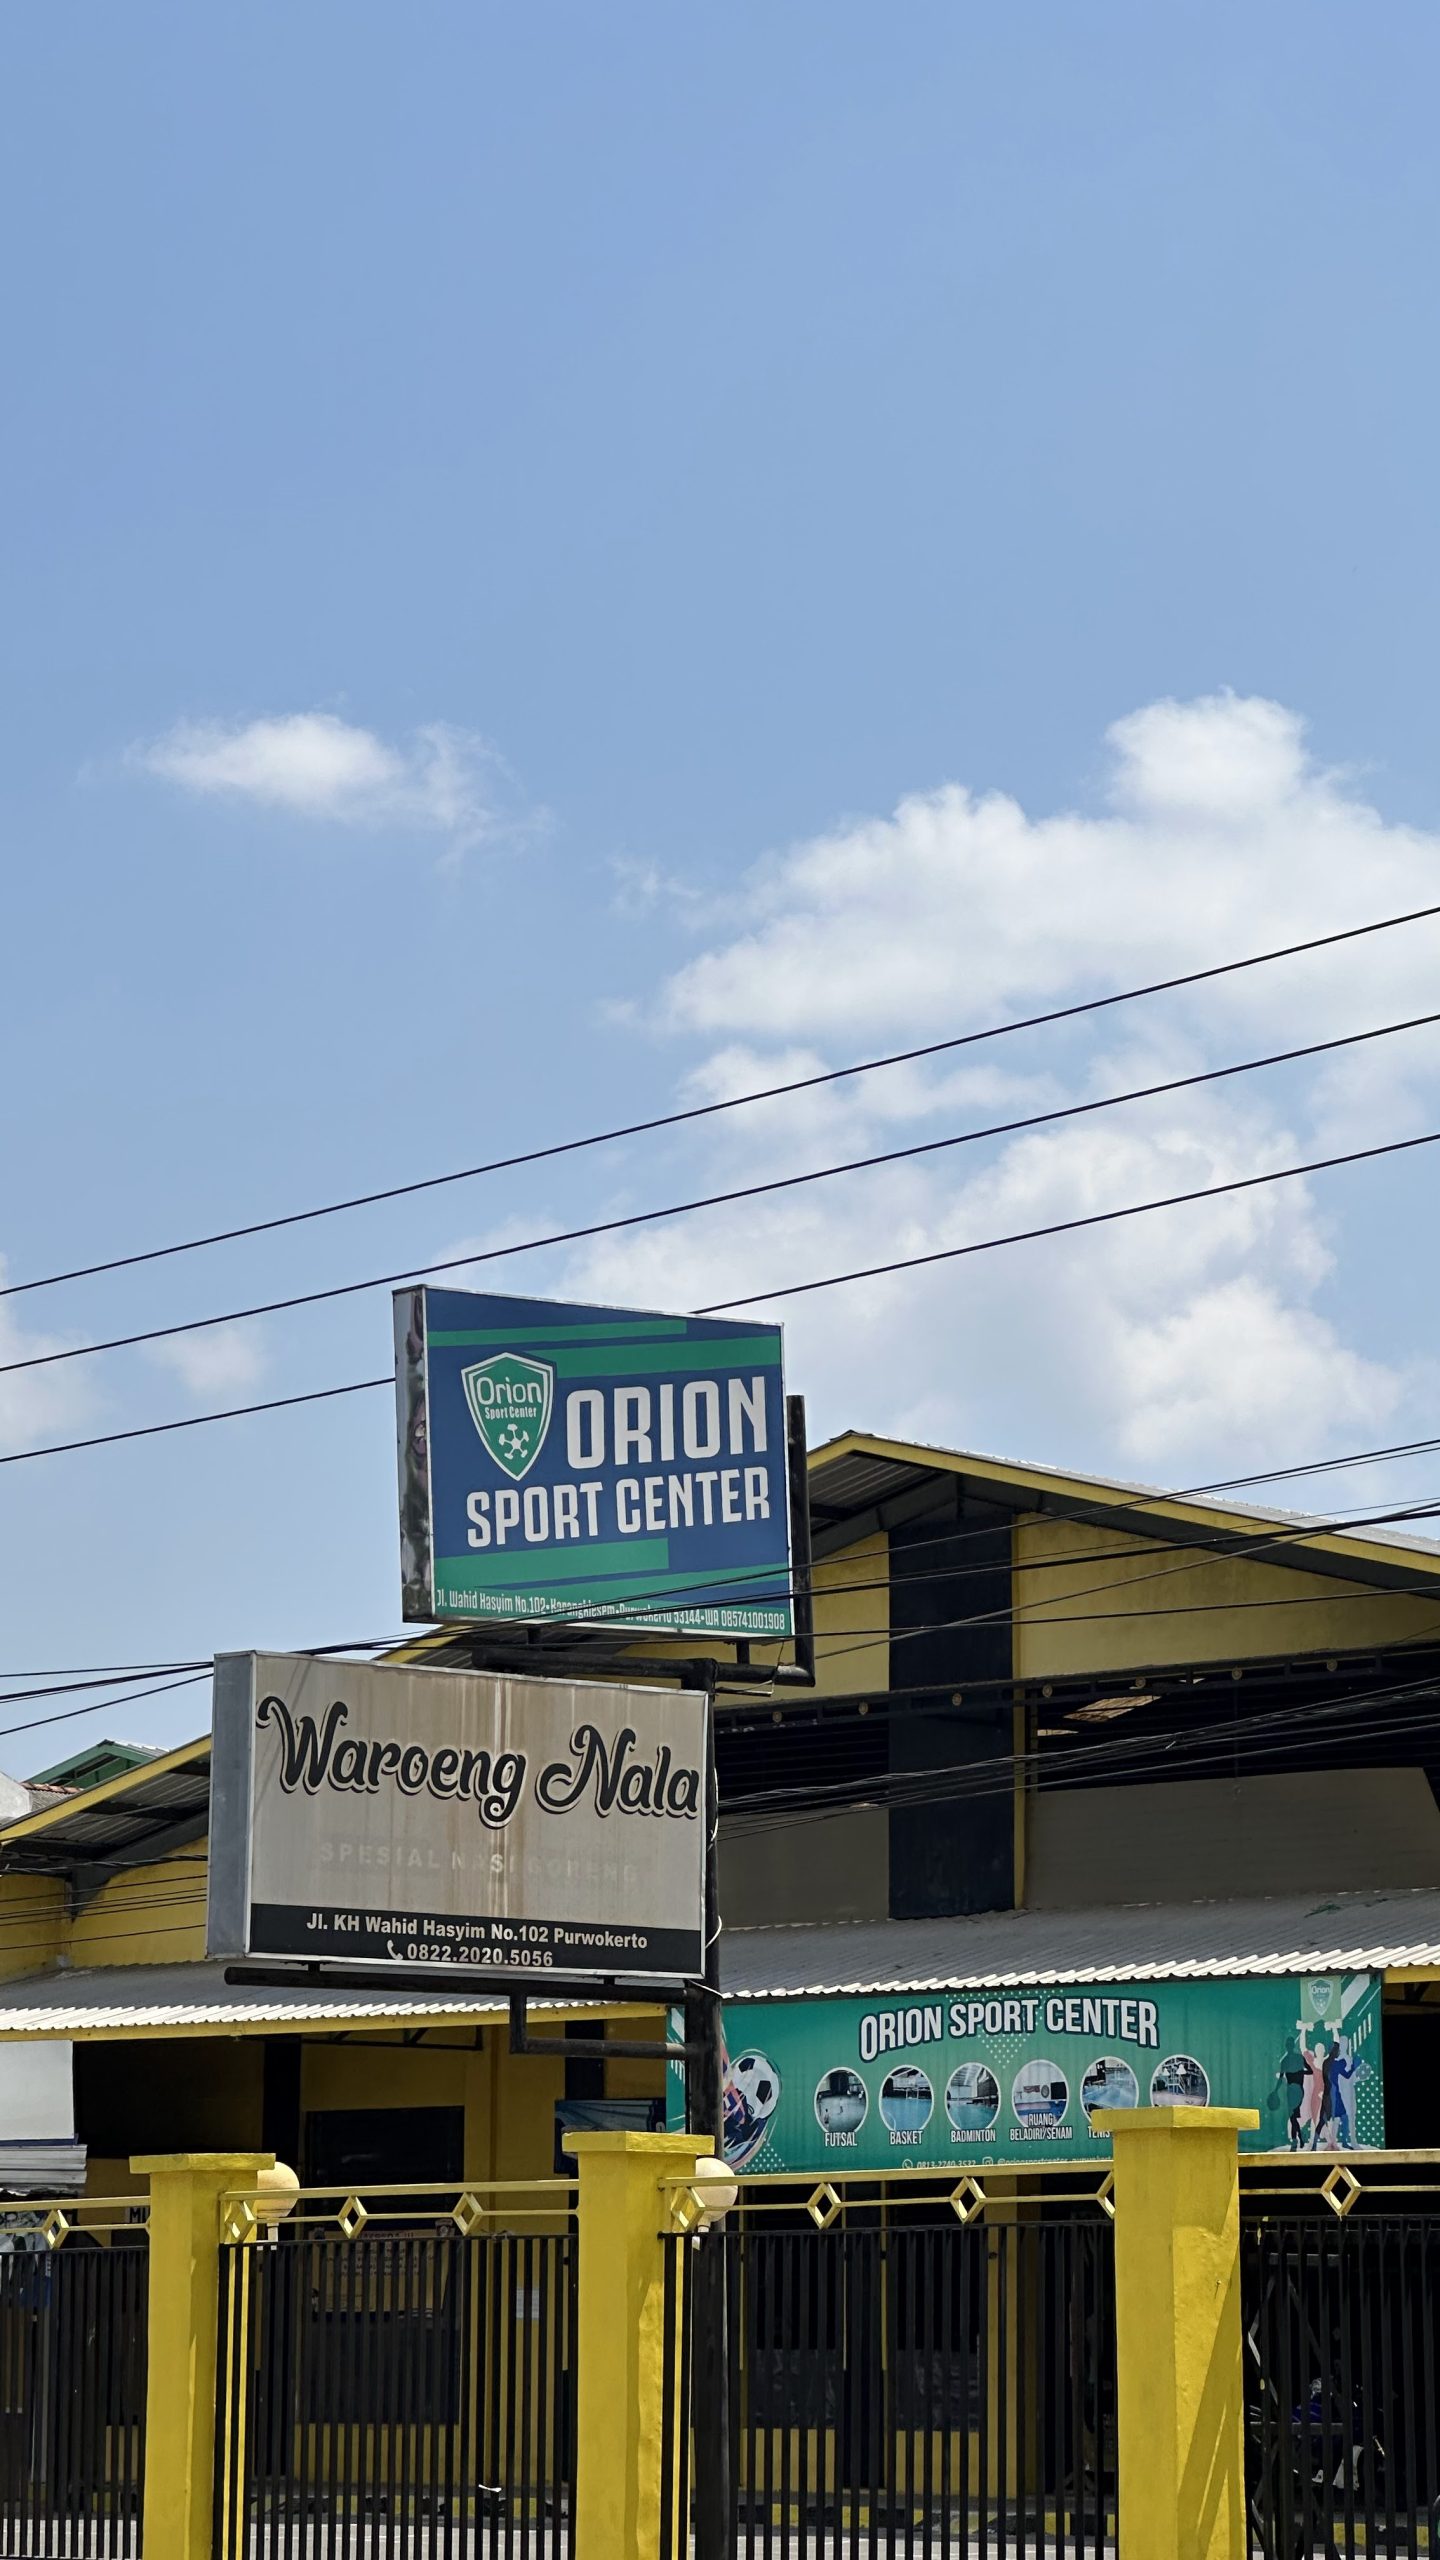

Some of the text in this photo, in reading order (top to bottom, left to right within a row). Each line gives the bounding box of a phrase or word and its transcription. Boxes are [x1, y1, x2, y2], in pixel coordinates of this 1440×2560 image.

[476, 1376, 542, 1405] Orion
[485, 1406, 537, 1420] Sport Center
[566, 1376, 768, 1469] ORION
[466, 1466, 770, 1548] SPORT CENTER
[449, 1590, 477, 1609] Wahid
[479, 1593, 513, 1613] Hasyim
[721, 1611, 785, 1630] 085741001908
[255, 1695, 700, 1829] Waroeng Nala
[306, 1913, 648, 1949] Jl. KH Wahid Hasyim No.102 Purwokerto
[407, 1943, 553, 1967] 0822.2020.5056
[860, 1998, 1159, 2060] ORION SPORT CENTER
[1028, 2112, 1053, 2126] RUANG
[824, 2131, 858, 2147] FUTSAL
[889, 2130, 923, 2145] BASKET
[950, 2129, 996, 2143] BADMINTON
[1010, 2126, 1073, 2141] BELADIRI/SENAM
